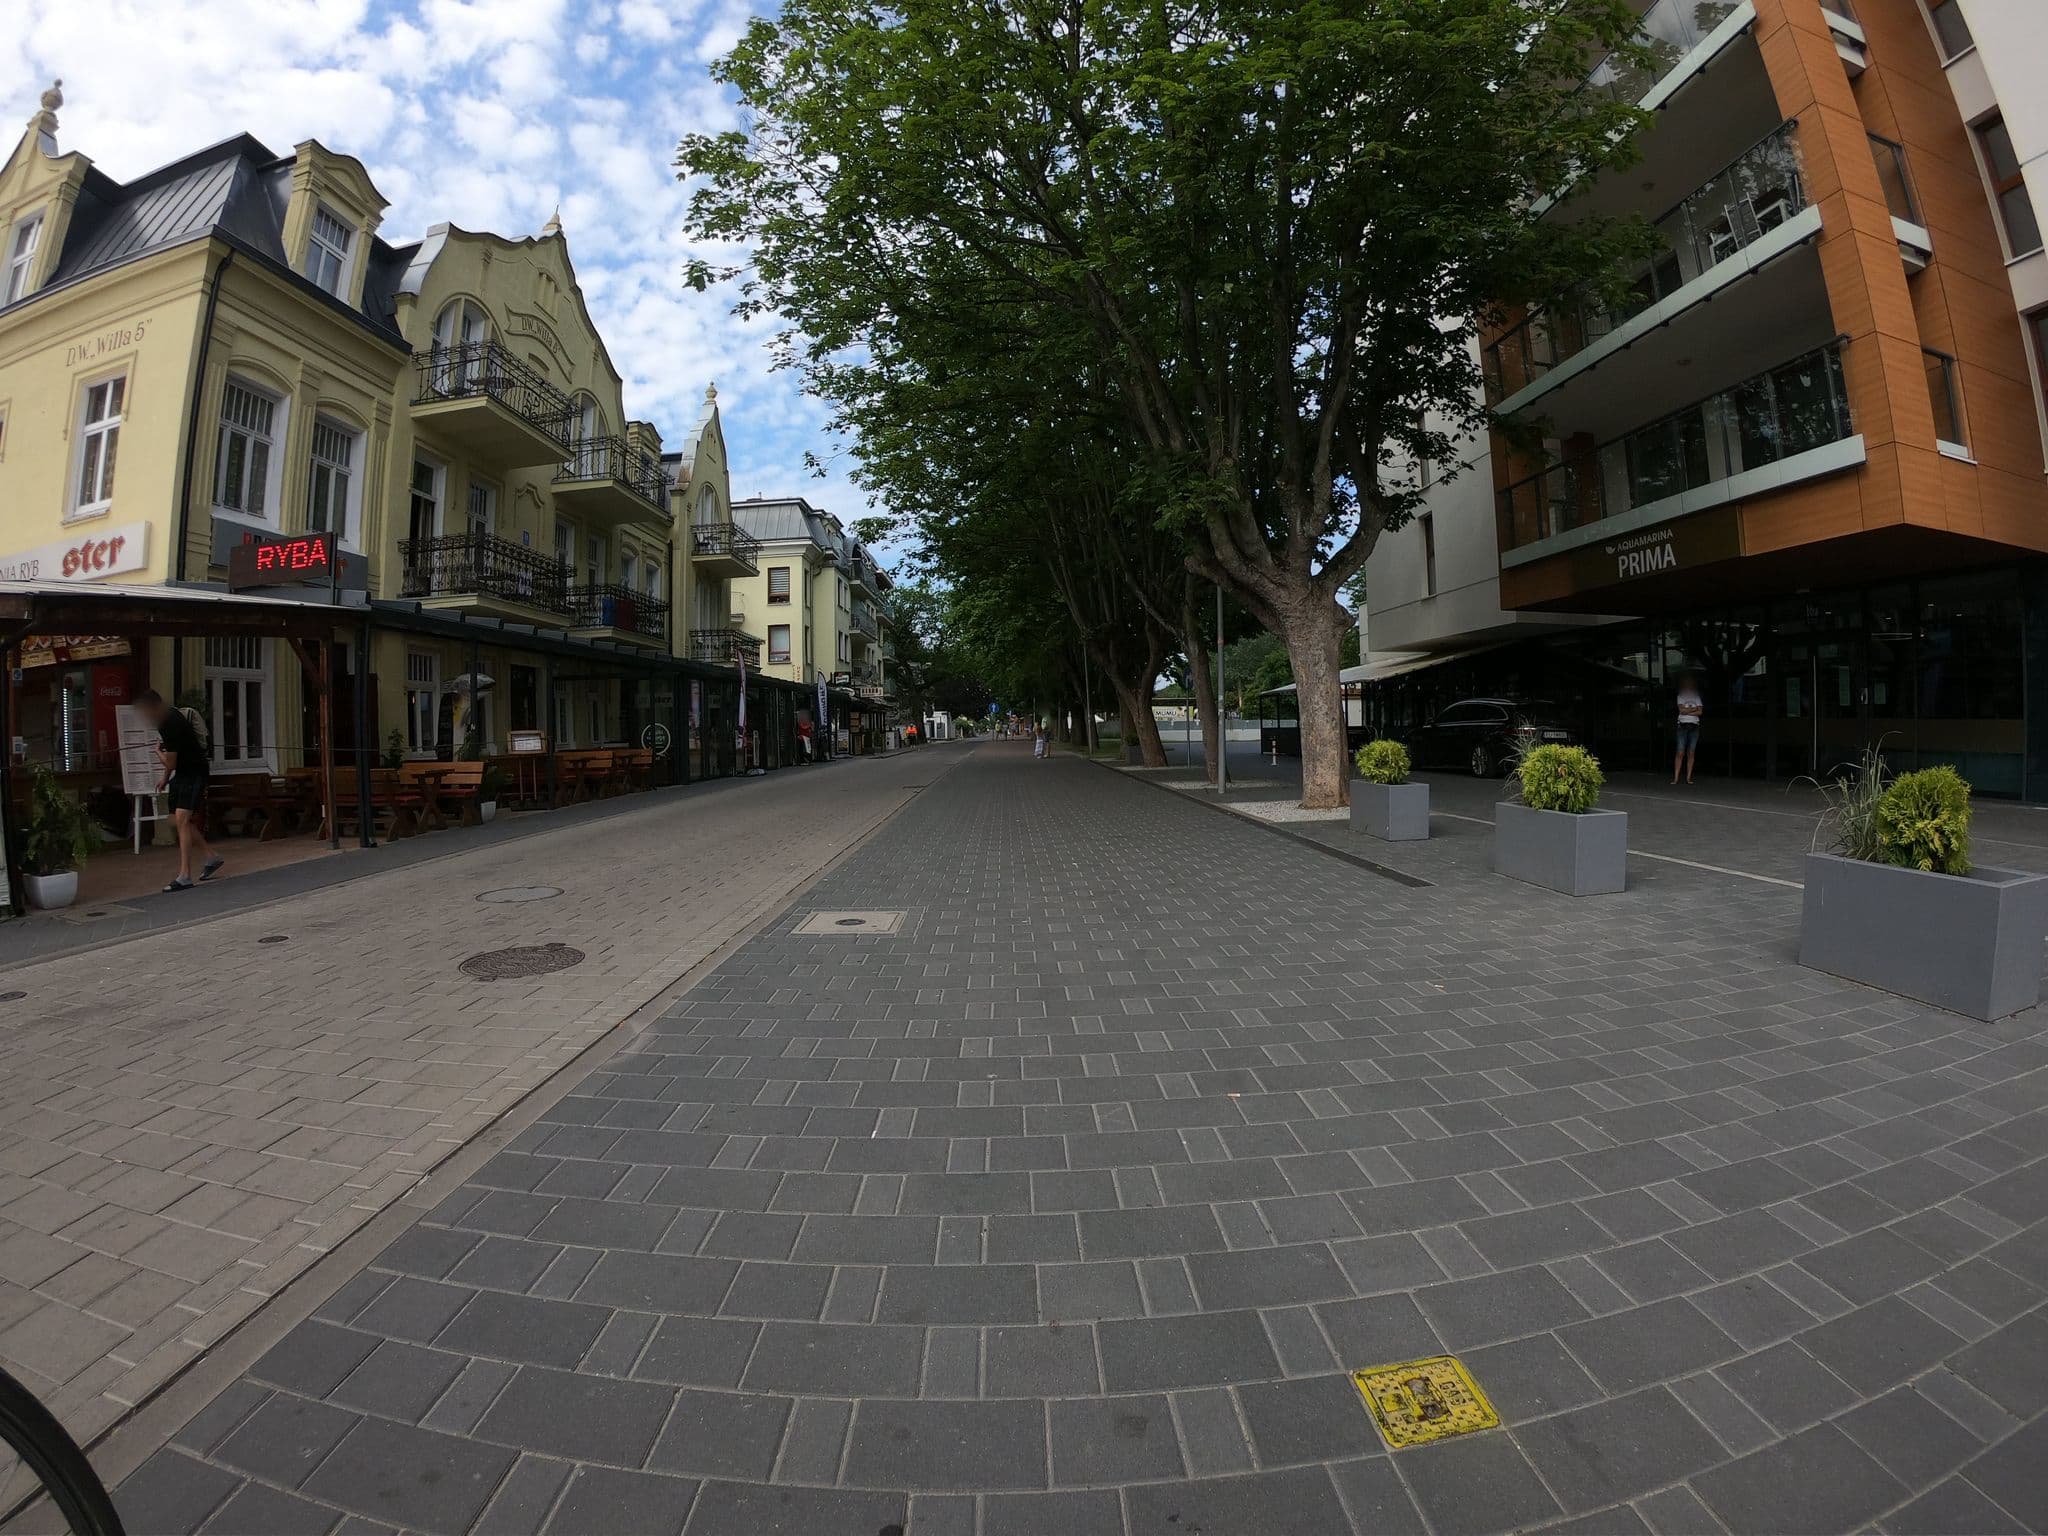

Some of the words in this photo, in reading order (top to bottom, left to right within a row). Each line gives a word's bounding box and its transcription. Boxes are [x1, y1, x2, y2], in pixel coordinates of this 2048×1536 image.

[257, 537, 328, 570] RYBA
[1617, 528, 1674, 552] AQUAMARINA
[20, 559, 40, 579] RYB
[1618, 543, 1677, 578] PRIMA
